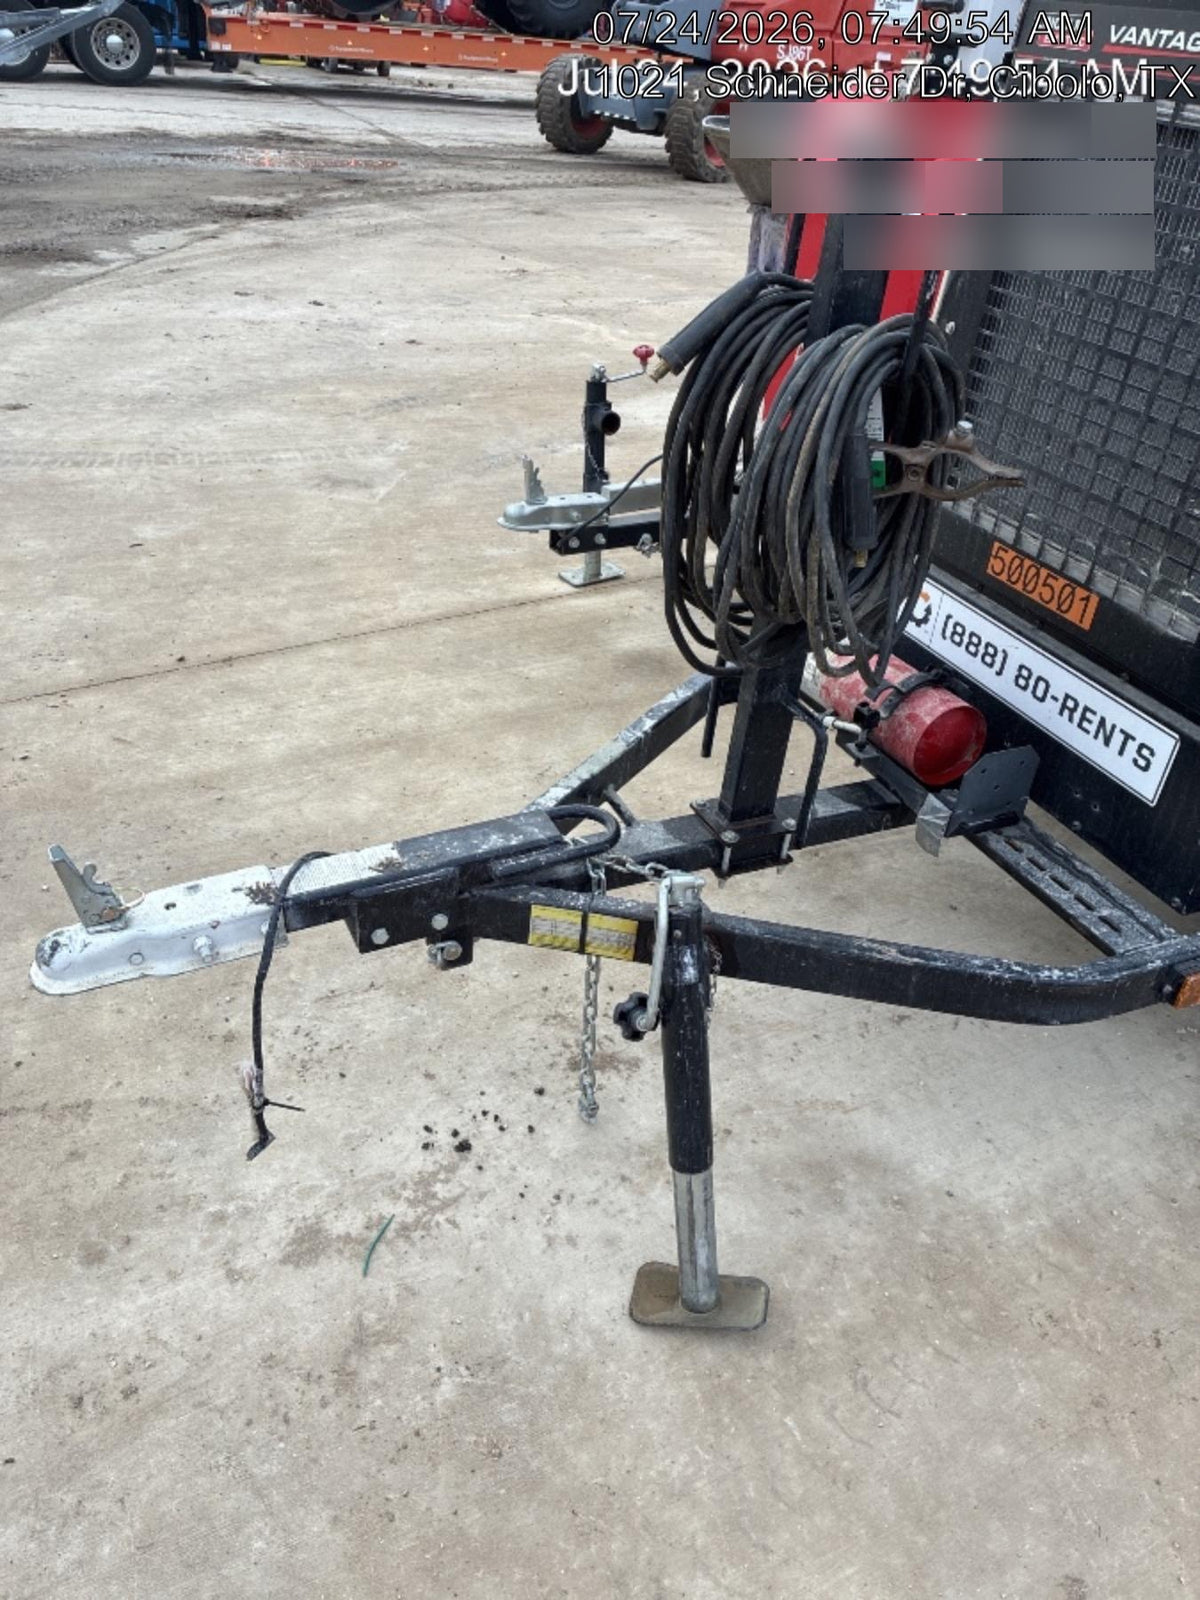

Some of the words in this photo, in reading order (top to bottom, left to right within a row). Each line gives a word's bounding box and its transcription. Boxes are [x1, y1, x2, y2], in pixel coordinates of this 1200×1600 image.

[991, 545, 1093, 624] 500501
[941, 614, 1008, 676] (888)
[1014, 664, 1156, 773] 80-RENTS
